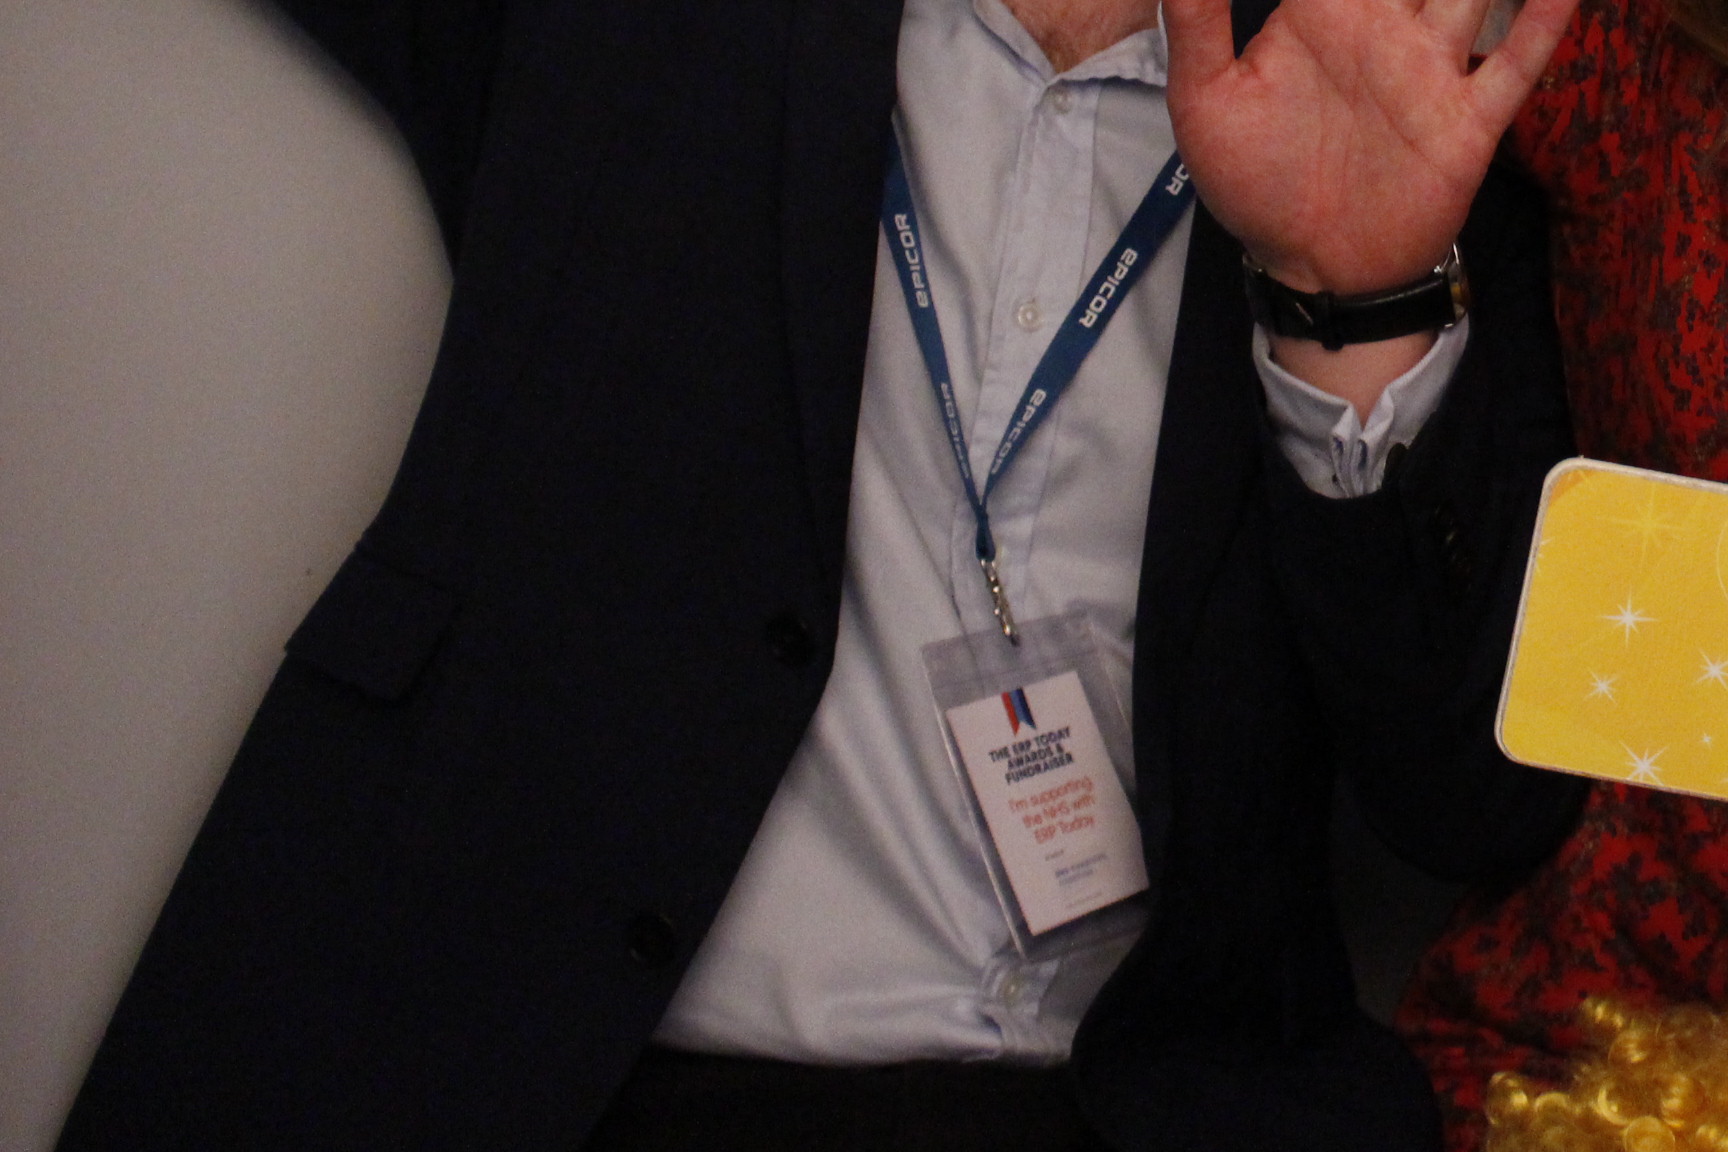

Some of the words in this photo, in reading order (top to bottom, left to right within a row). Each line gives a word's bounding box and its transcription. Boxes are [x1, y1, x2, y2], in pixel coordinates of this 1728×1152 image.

[989, 746, 1011, 763] THE
[1036, 727, 1070, 746] TODAY
[1007, 746, 1054, 770] AWARDS
[1005, 753, 1074, 785] FUNDRAISER
[1030, 776, 1093, 806] supporting
